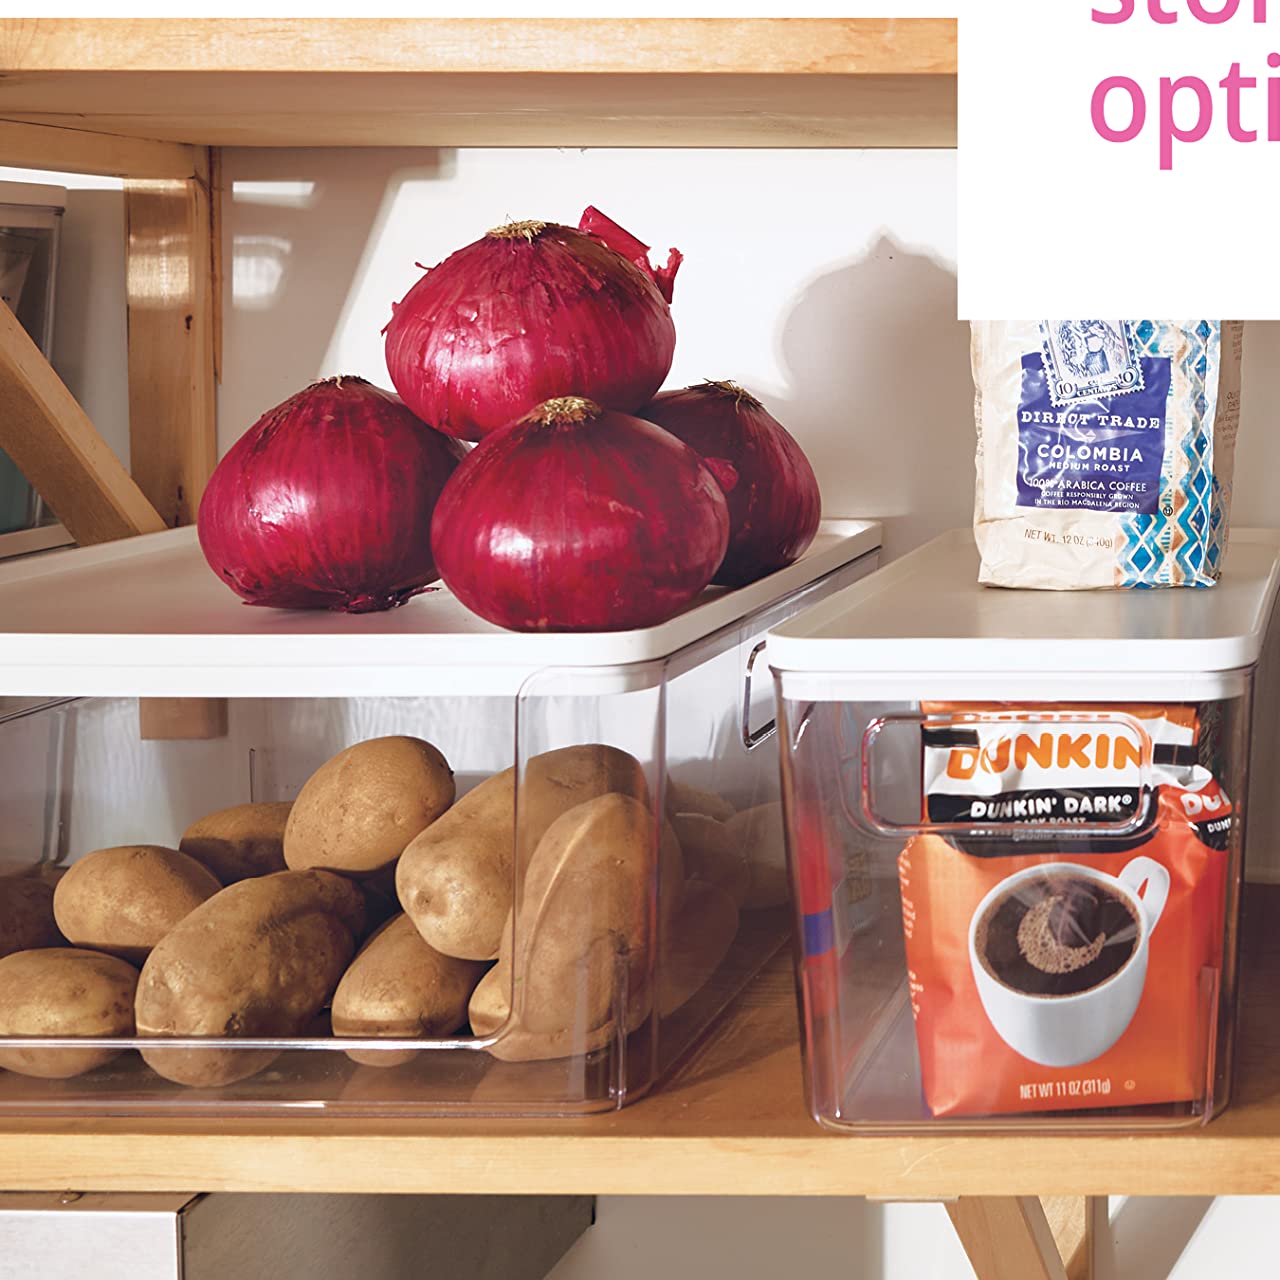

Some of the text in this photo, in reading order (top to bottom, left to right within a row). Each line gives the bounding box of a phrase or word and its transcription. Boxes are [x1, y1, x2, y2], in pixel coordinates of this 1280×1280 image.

[1021, 411, 1160, 429] DIRECT TRADE
[1037, 444, 1143, 462] COLOMBIA
[1049, 462, 1131, 472] MEDIUM ROAST
[1057, 480, 1106, 490] ARABICA
[1109, 481, 1147, 492] COFFEE
[1072, 500, 1113, 508] MAGDALENA
[1024, 528, 1041, 540] NET
[1062, 533, 1073, 544] 12
[1073, 534, 1086, 545] OZ
[946, 732, 1152, 781] DUNKIN
[970, 797, 1058, 819] DUNKIN'
[1020, 1083, 1037, 1099] NET
[1038, 1082, 1054, 1098] WT
[1056, 1081, 1066, 1096] 11
[1068, 1080, 1081, 1096] OZ
